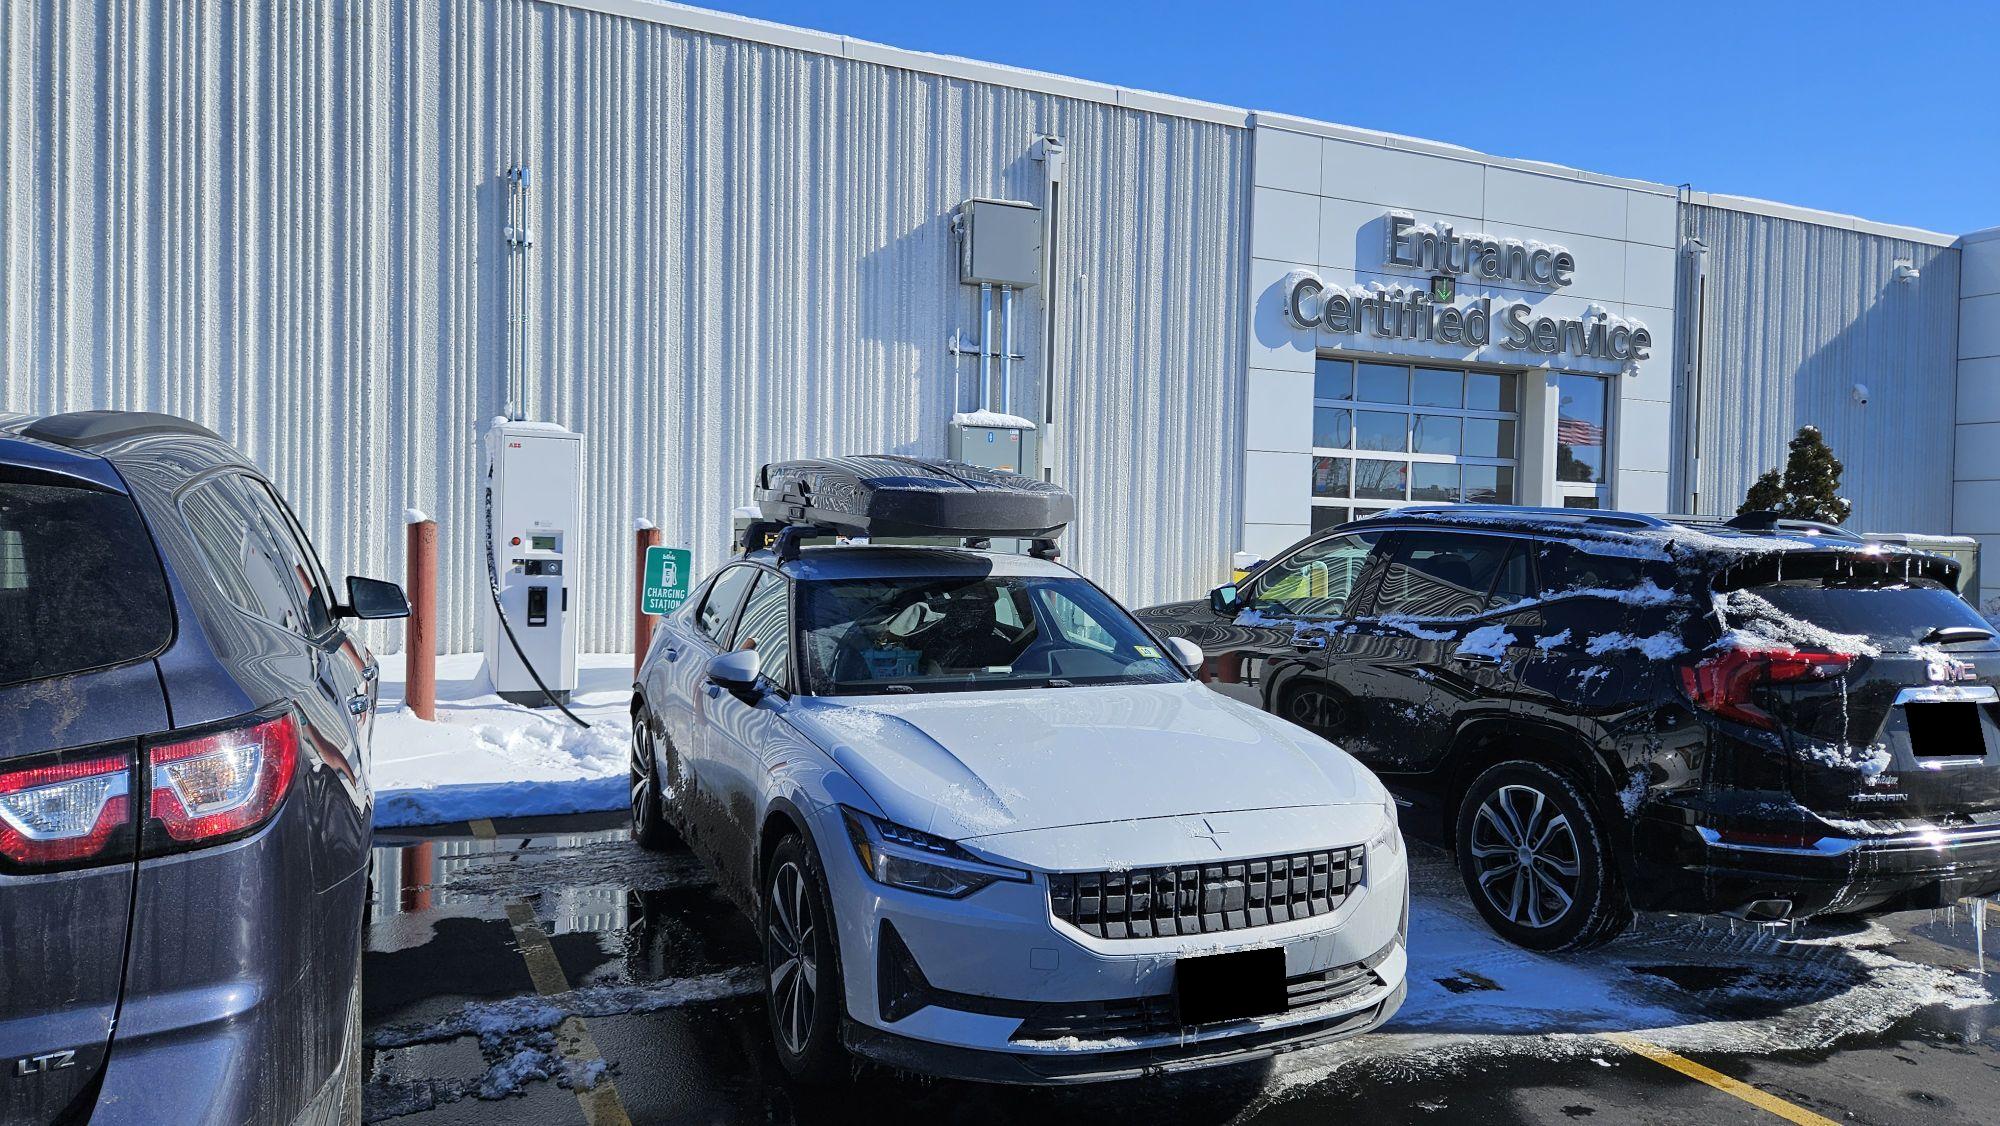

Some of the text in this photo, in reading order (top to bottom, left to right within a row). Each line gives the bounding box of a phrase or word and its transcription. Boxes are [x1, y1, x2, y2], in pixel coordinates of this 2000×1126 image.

[1389, 215, 1576, 287] Entrance
[1289, 277, 1652, 361] Certified Service
[647, 588, 685, 599] CHARGING
[650, 599, 681, 609] STATION
[1927, 662, 1977, 681] GMC
[1848, 793, 1908, 802] TERRAIN
[18, 1050, 75, 1076] LTZ
